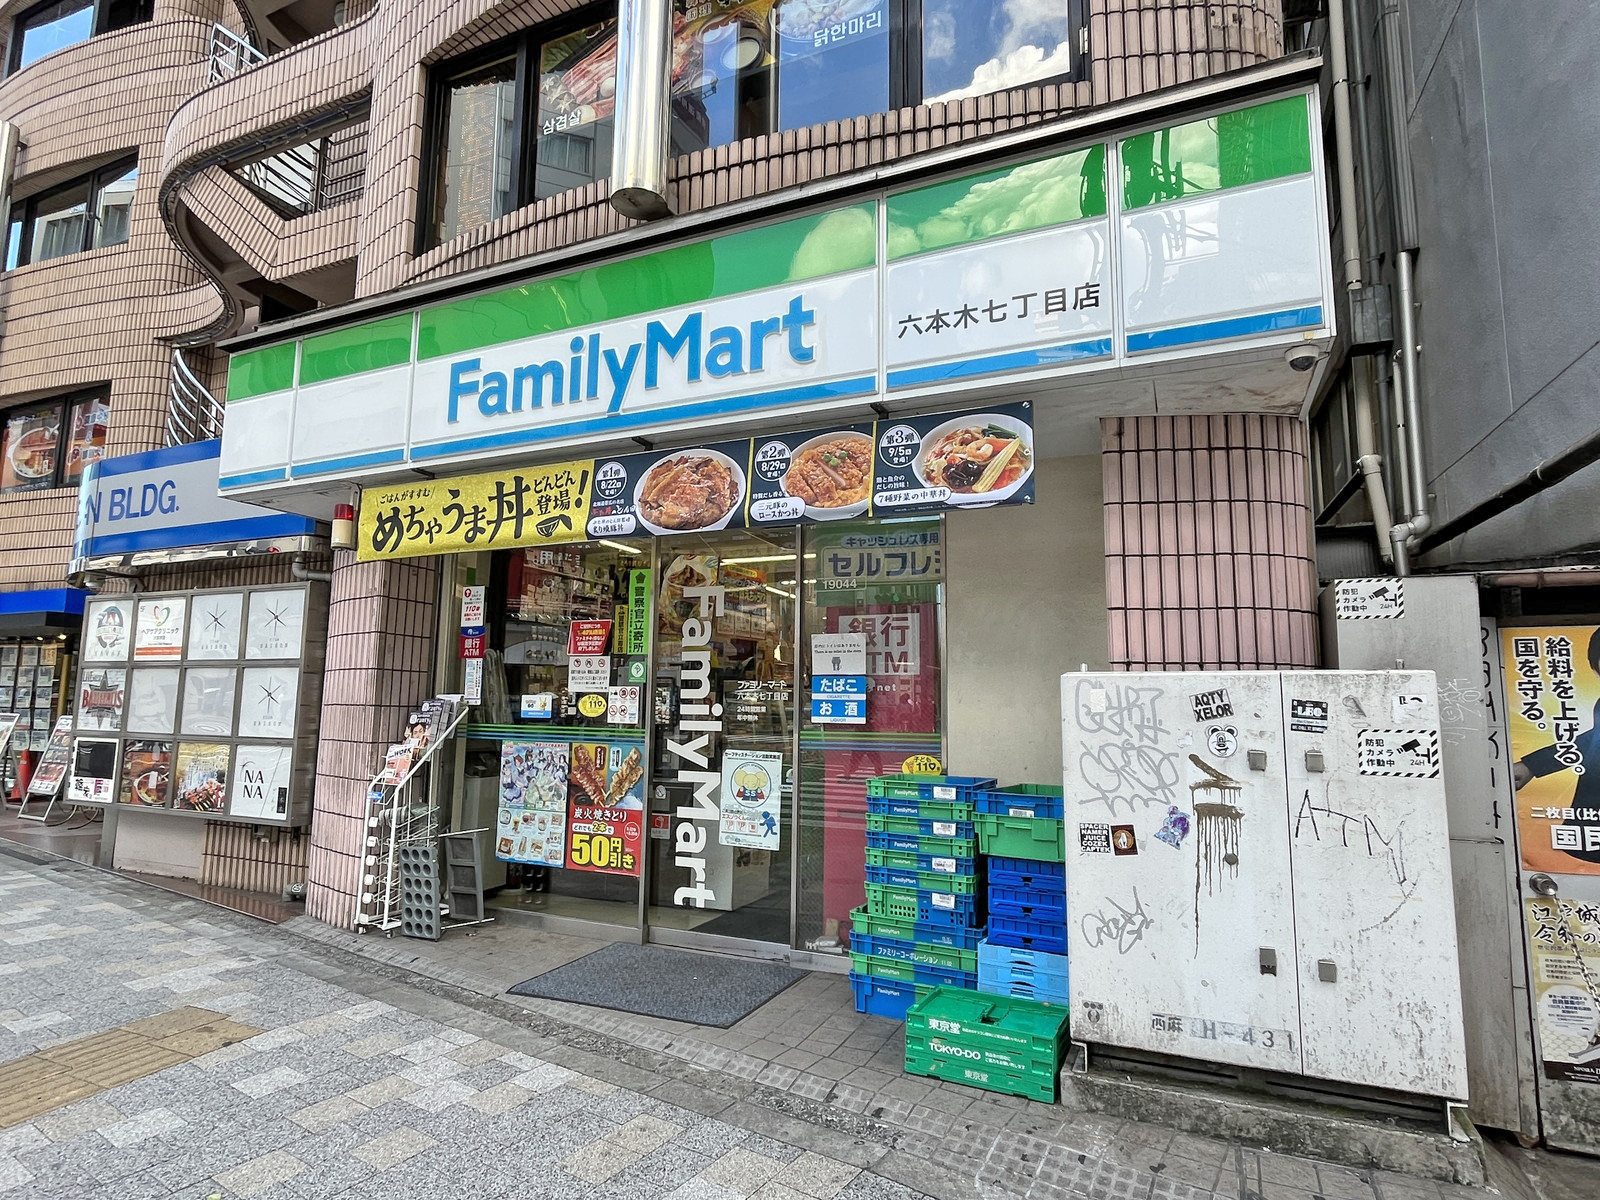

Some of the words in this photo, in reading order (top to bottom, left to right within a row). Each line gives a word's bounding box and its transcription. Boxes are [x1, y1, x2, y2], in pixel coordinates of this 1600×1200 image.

[813, 10, 882, 47] 닭한마리
[542, 109, 582, 136] 삼겹살
[898, 282, 1100, 340] 六本木七丁目店
[447, 295, 816, 424] FamilyMart
[533, 470, 576, 493] どんどん
[109, 480, 180, 520] BLDG.
[379, 490, 431, 505] ごはんがすすむ
[879, 489, 946, 503] 7種野菜の中華丼
[372, 476, 533, 552] めちゃうま丼
[759, 508, 799, 519] ロースかつ丼
[846, 532, 939, 548] キャッシュレス専用
[823, 579, 857, 590] 19044
[633, 586, 645, 652] 警察官立寄所
[847, 616, 910, 647] 銀行
[464, 648, 480, 656] ATM
[737, 680, 787, 690] ファミリーマート
[820, 678, 858, 692] たばこ
[1514, 638, 1546, 730] 国を守る。
[1194, 690, 1224, 708] AQTY
[1545, 637, 1586, 775] 給料を上げる。
[1194, 703, 1233, 722] XELOR
[666, 586, 725, 908] FamilyMart
[1365, 738, 1385, 747] 防犯
[1366, 748, 1394, 756] カメラ
[1366, 758, 1395, 767] 作動中
[244, 770, 264, 784] NA
[242, 785, 263, 799] NA
[894, 789, 919, 797] FamilyMart
[574, 807, 627, 823] 炭火焼きとり
[893, 806, 918, 814] FamilyMart
[894, 841, 919, 849] FamilyMart
[892, 876, 917, 884] FamilyMart
[892, 894, 917, 902] FamilyMart
[877, 927, 900, 935] FamilyMart
[877, 947, 939, 964] ファミリーコーポレーション
[877, 967, 900, 975] FamilyMart
[877, 987, 900, 996] FamilyMart
[928, 1018, 961, 1035] 東京堂
[929, 1042, 981, 1061] TOKYO-DO
[964, 1069, 989, 1083] 東京堂
